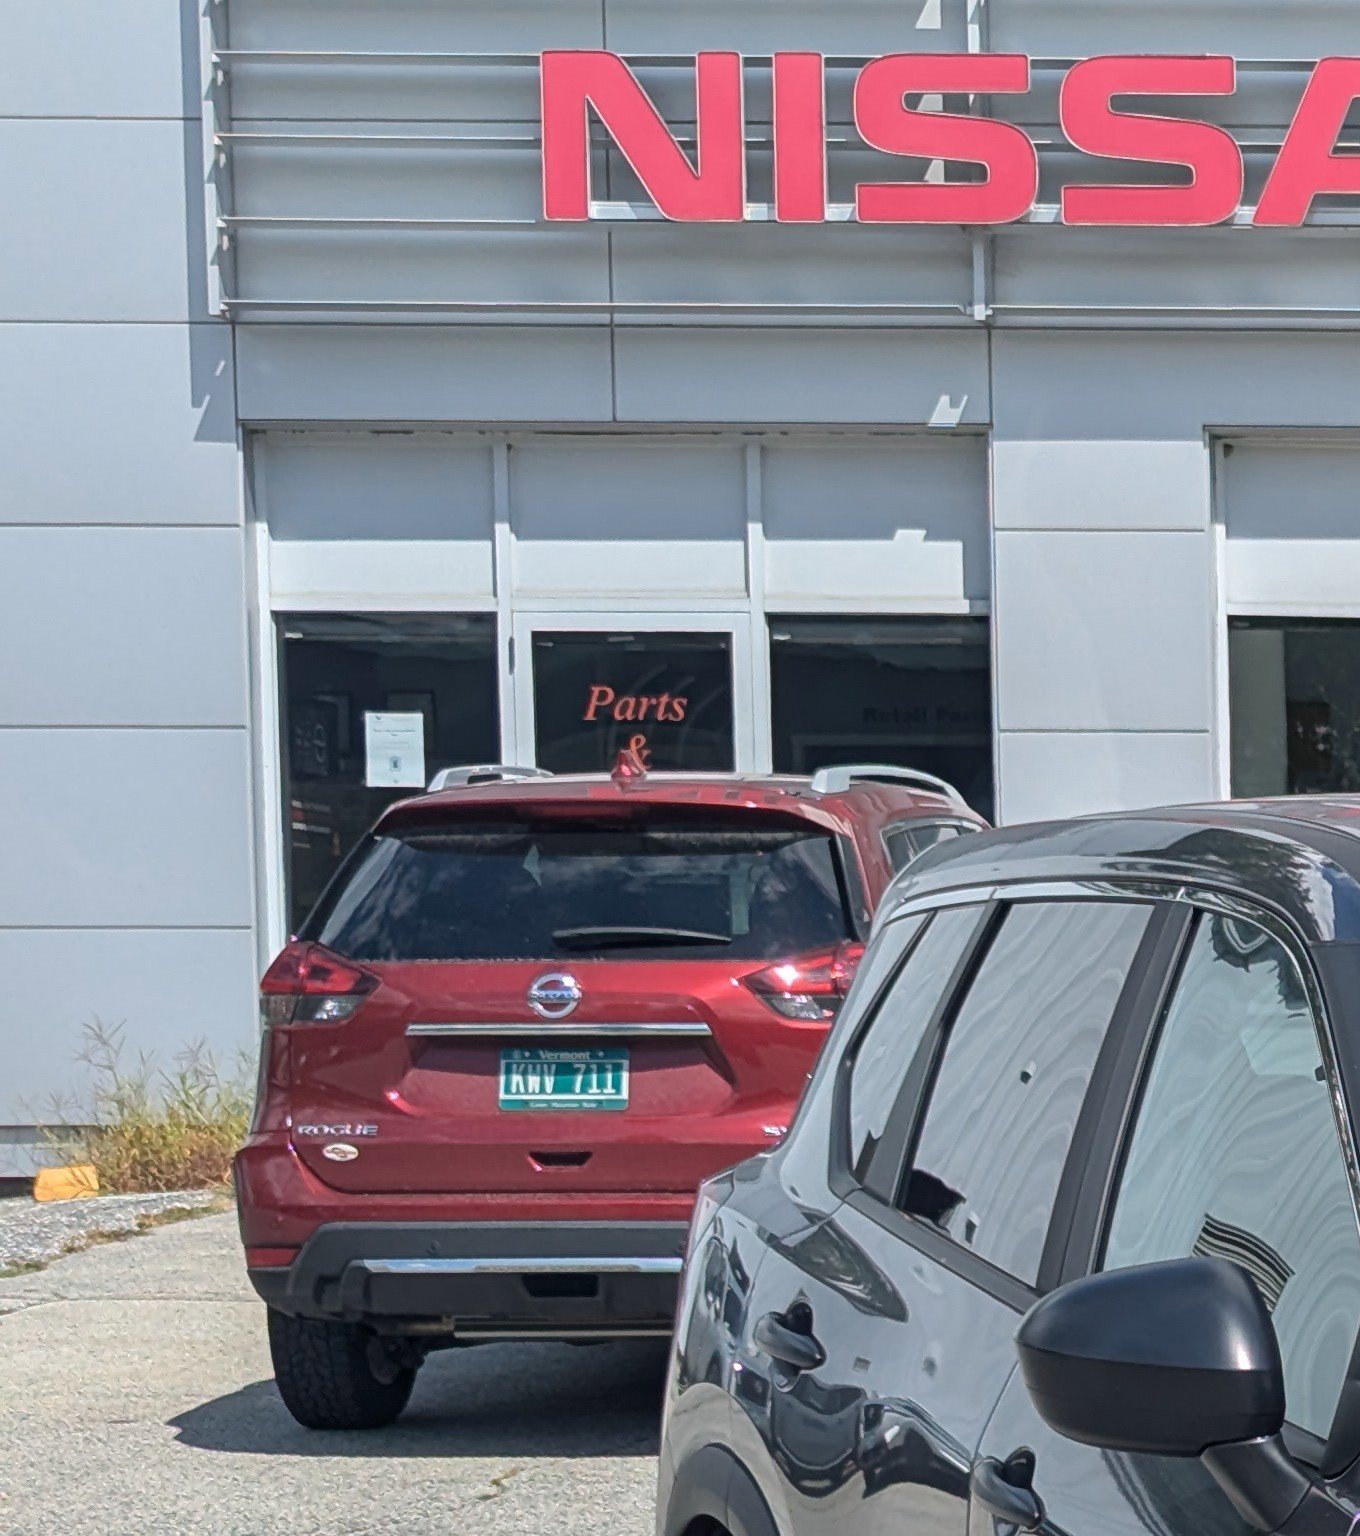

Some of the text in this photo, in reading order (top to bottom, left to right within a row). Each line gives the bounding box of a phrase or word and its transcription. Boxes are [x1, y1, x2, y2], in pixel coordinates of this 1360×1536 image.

[582, 685, 688, 721] Parts
[573, 1063, 616, 1094] 711
[298, 1124, 378, 1136] ROGUE
